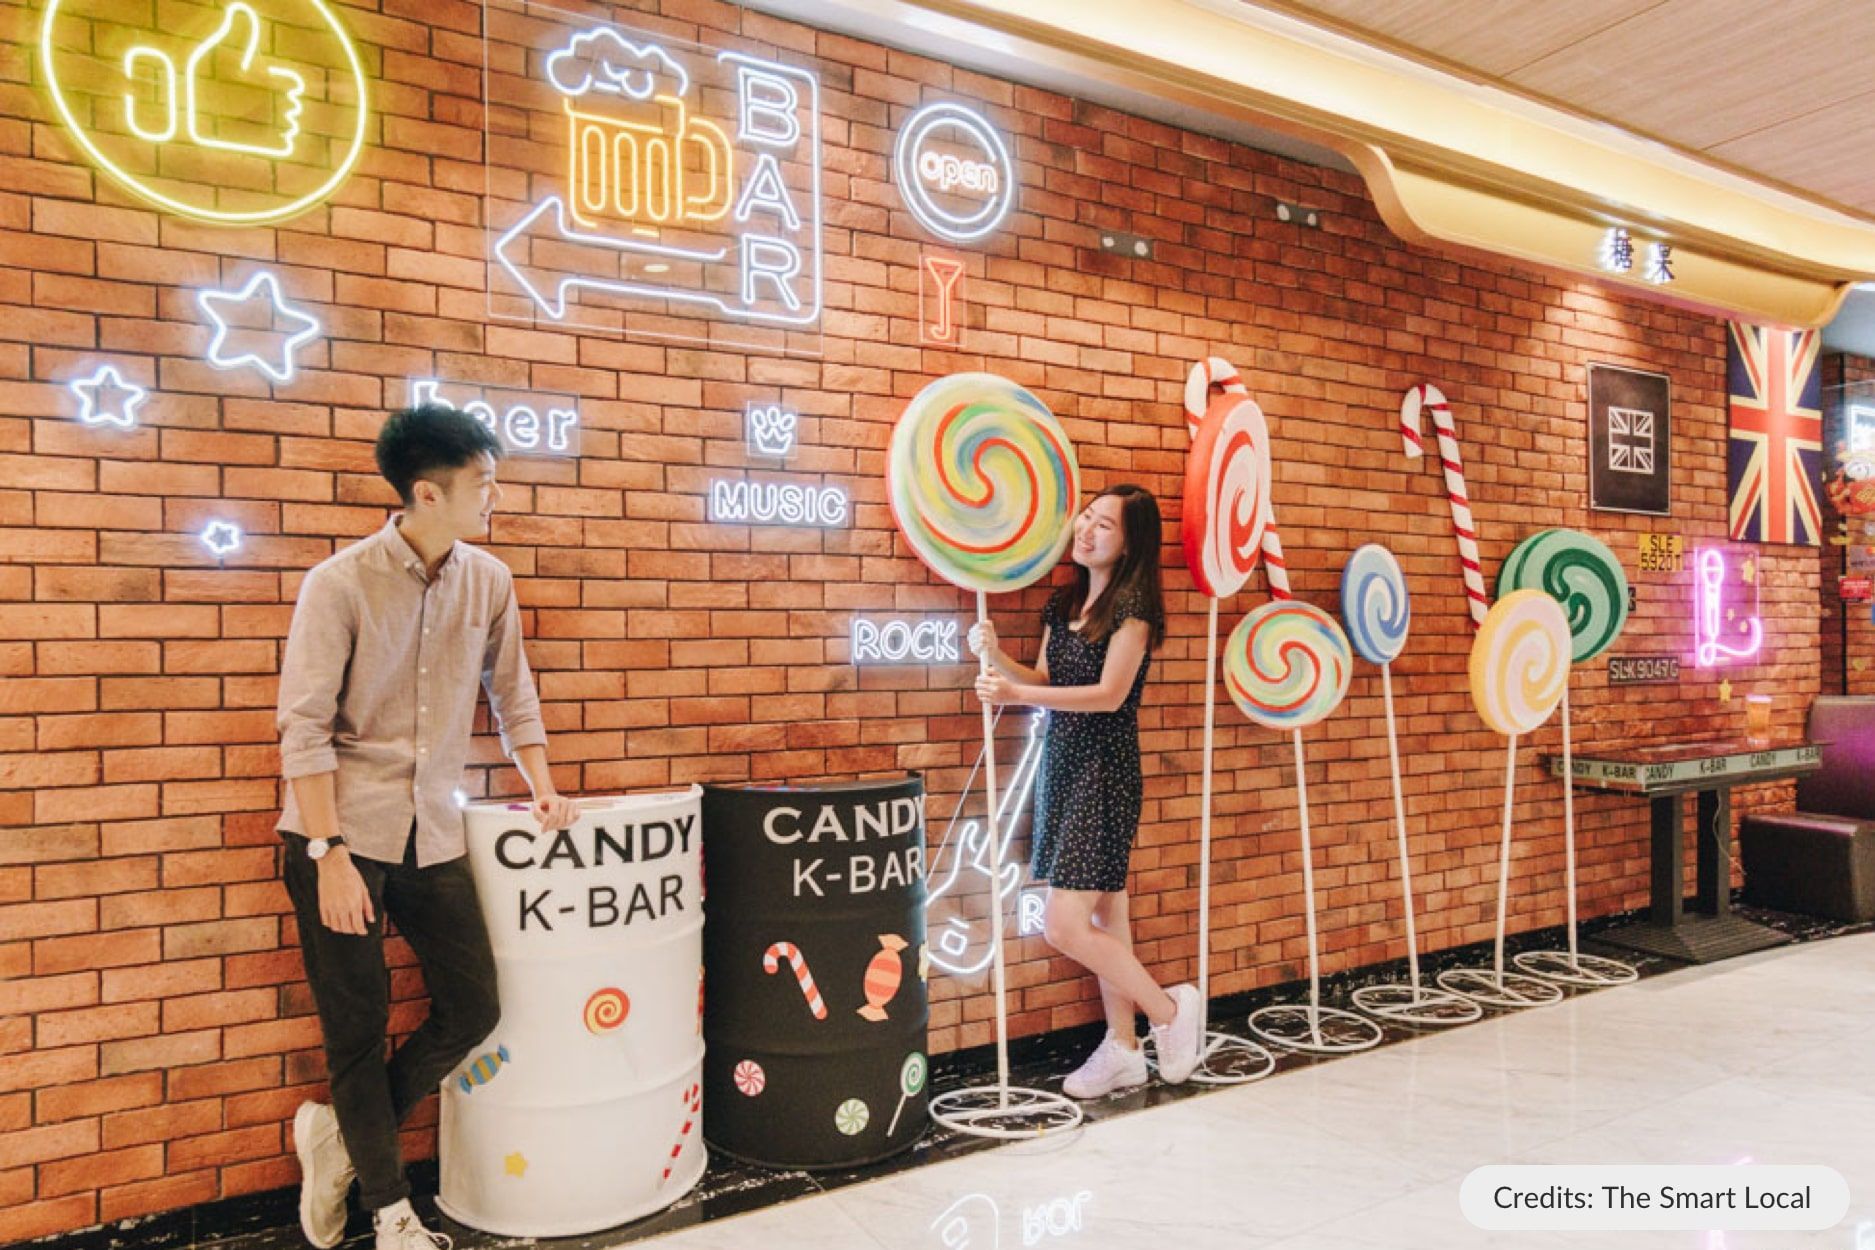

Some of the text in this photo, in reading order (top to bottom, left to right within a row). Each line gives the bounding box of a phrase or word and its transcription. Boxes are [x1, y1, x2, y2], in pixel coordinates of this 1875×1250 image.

[737, 64, 801, 311] BAR
[920, 150, 998, 193] open
[714, 480, 846, 524] MUSIC
[853, 619, 958, 660] ROCK
[1556, 759, 1638, 780] CNDY K-BAR
[494, 814, 696, 870] CANDY
[762, 794, 927, 845] CANDY
[792, 846, 925, 897] K-BAR
[519, 874, 684, 931] K-BAR
